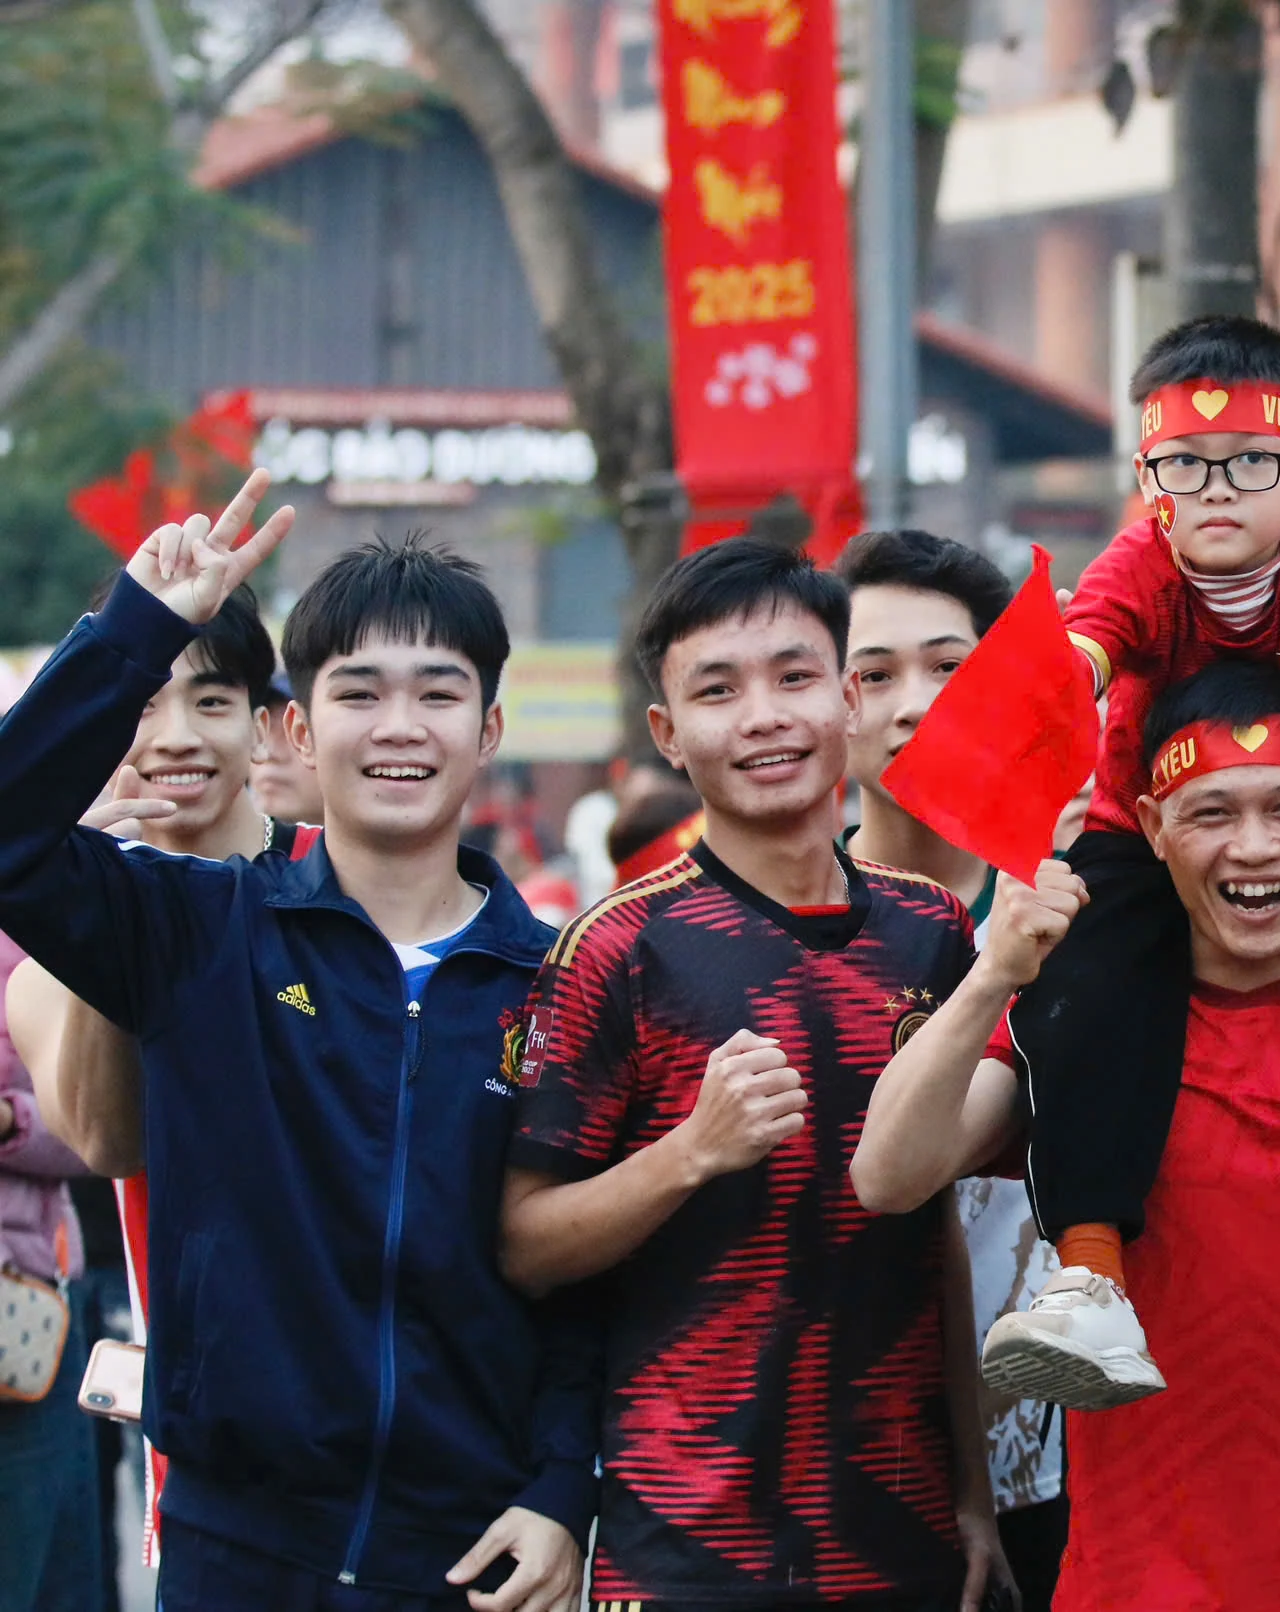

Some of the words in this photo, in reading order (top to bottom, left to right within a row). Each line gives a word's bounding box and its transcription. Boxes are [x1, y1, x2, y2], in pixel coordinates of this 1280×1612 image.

[687, 258, 815, 325] 2025
[1141, 401, 1162, 440] YÊU
[1160, 738, 1196, 784] YÊU
[277, 990, 316, 1016] adidas
[485, 1078, 507, 1096] CÔNG
